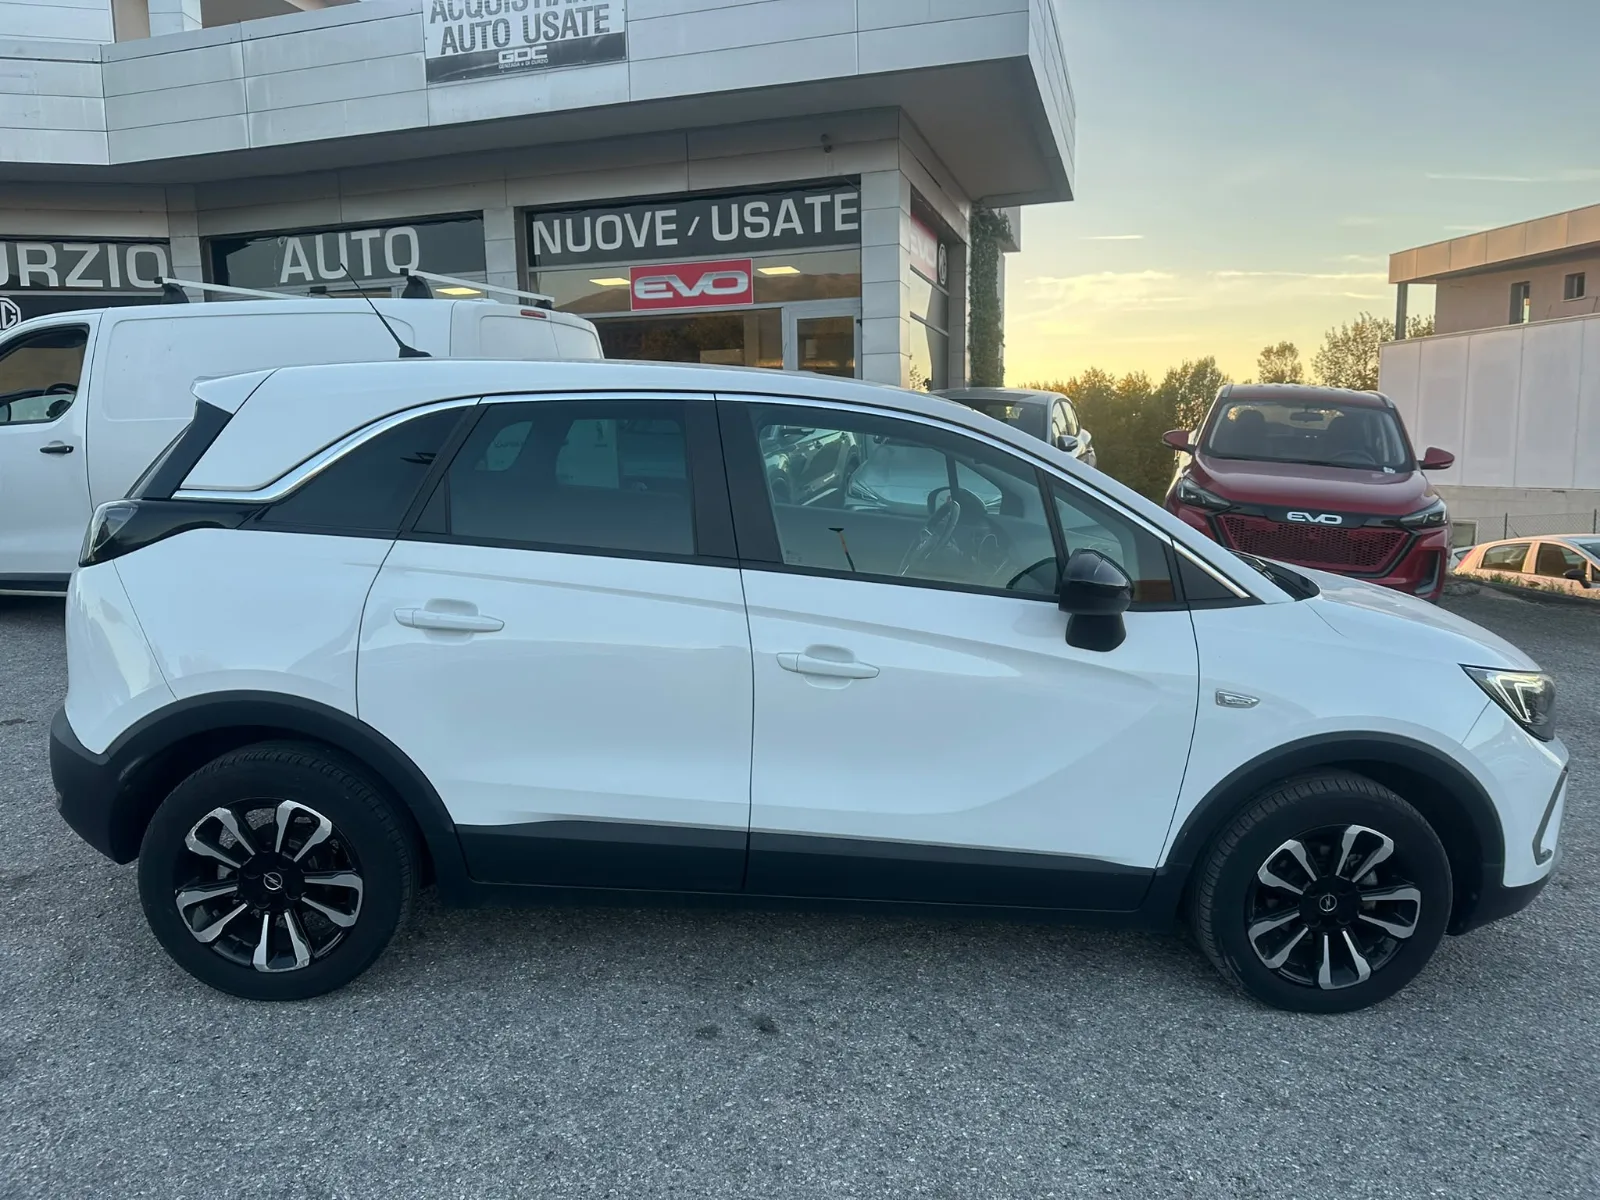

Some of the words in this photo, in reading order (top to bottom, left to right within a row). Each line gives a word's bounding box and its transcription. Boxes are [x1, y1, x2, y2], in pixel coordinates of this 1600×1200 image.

[440, 18, 511, 56] AUTO
[523, 4, 610, 44] USATE
[498, 45, 548, 64] GDC
[532, 209, 679, 255] NUOVE
[711, 192, 859, 242] USATE
[280, 226, 420, 283] AUTO
[633, 270, 749, 300] EVO
[1286, 511, 1343, 525] EVO
